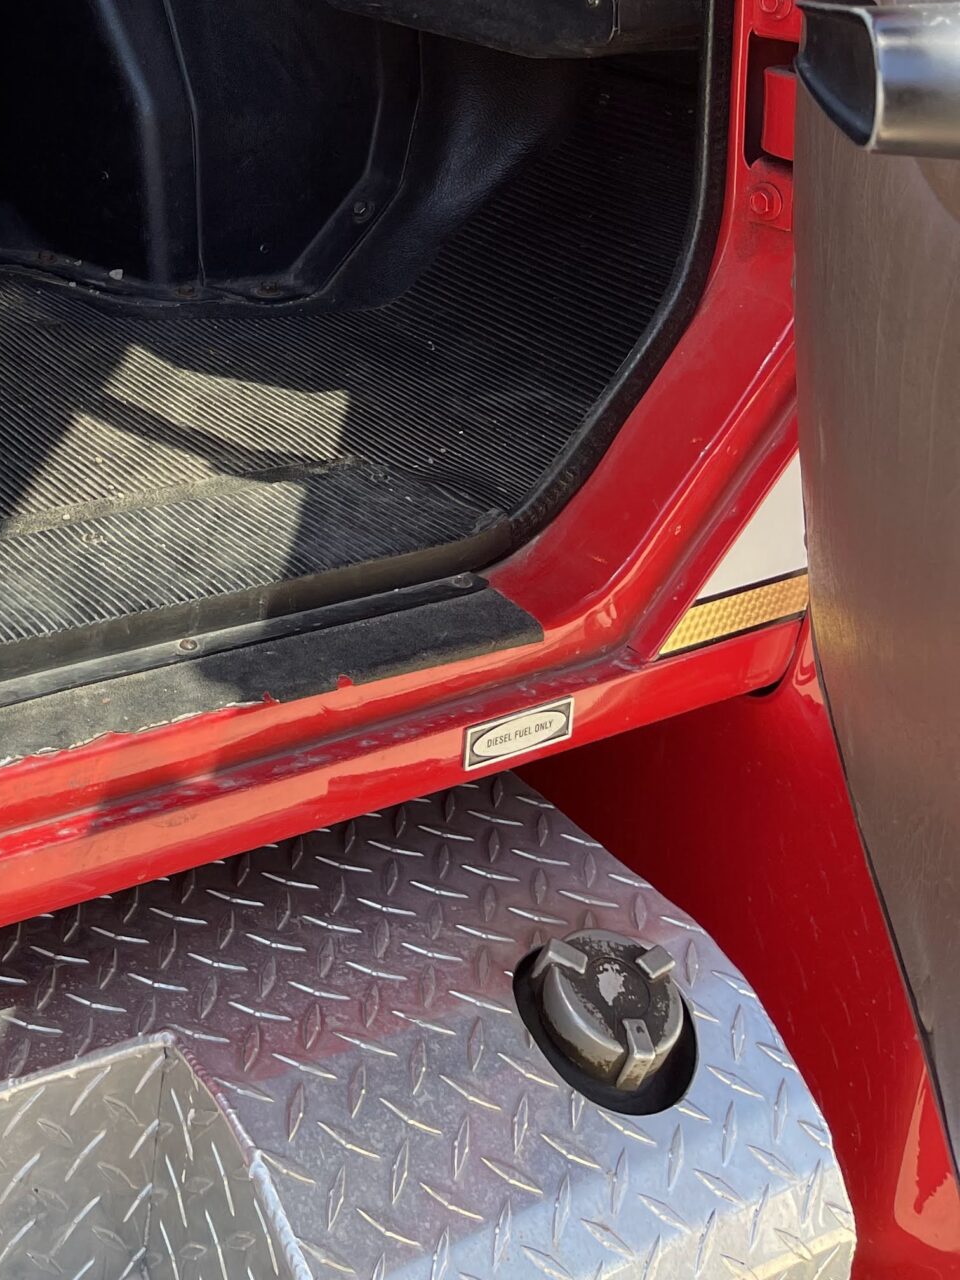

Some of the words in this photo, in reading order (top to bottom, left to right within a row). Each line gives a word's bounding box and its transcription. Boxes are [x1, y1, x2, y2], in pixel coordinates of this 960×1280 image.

[487, 733, 512, 748] DIESEL
[514, 726, 532, 740] FUEL
[534, 719, 553, 733] ONLY
